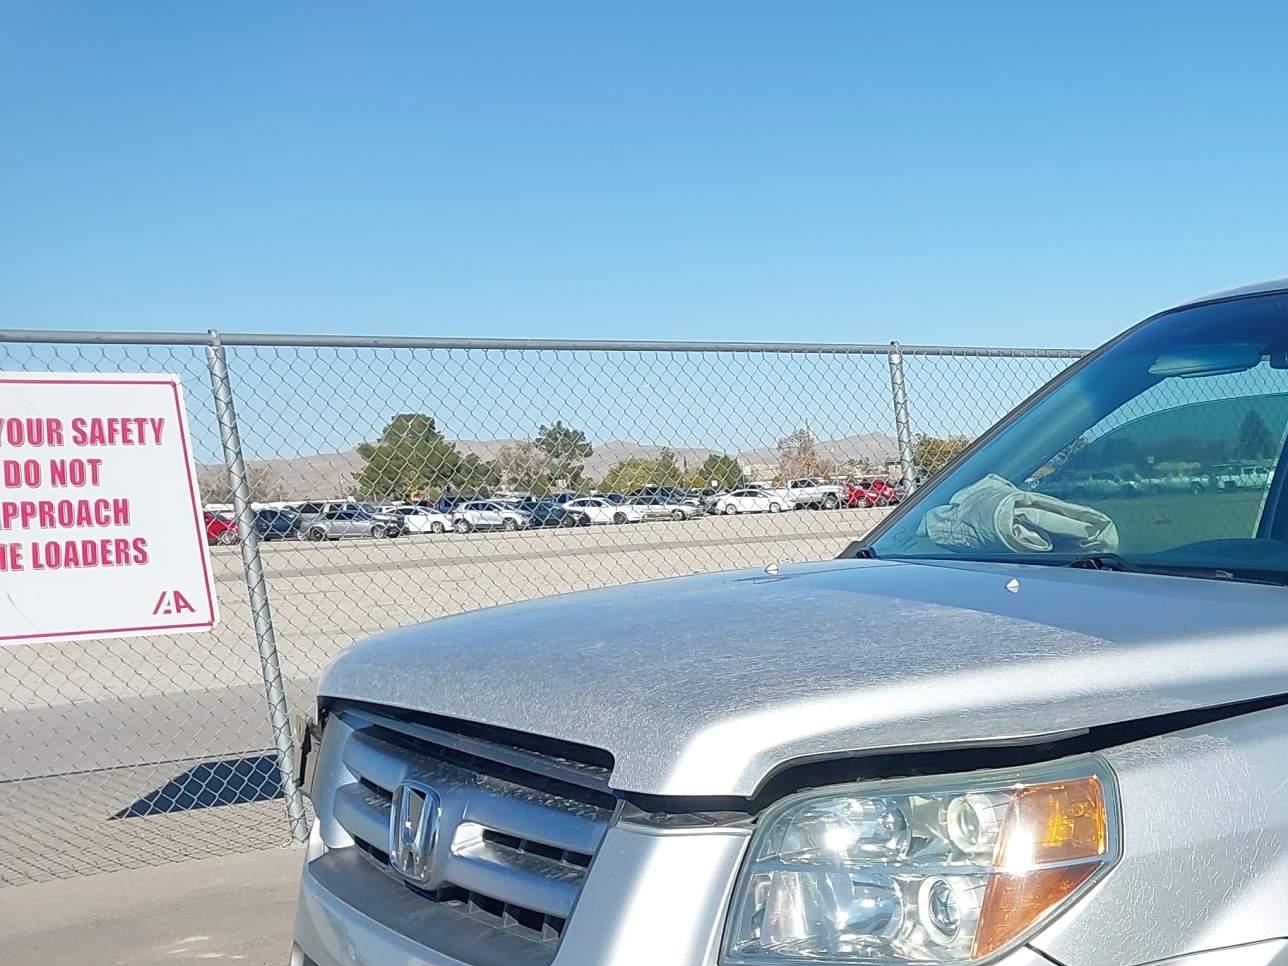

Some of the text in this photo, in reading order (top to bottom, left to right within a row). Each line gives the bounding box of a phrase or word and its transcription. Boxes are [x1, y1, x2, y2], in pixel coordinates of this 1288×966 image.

[0, 417, 165, 447] OUR SAFETY
[3, 458, 103, 488] DO NOT
[0, 498, 131, 530] PPROACH
[32, 537, 149, 570] LOADERS
